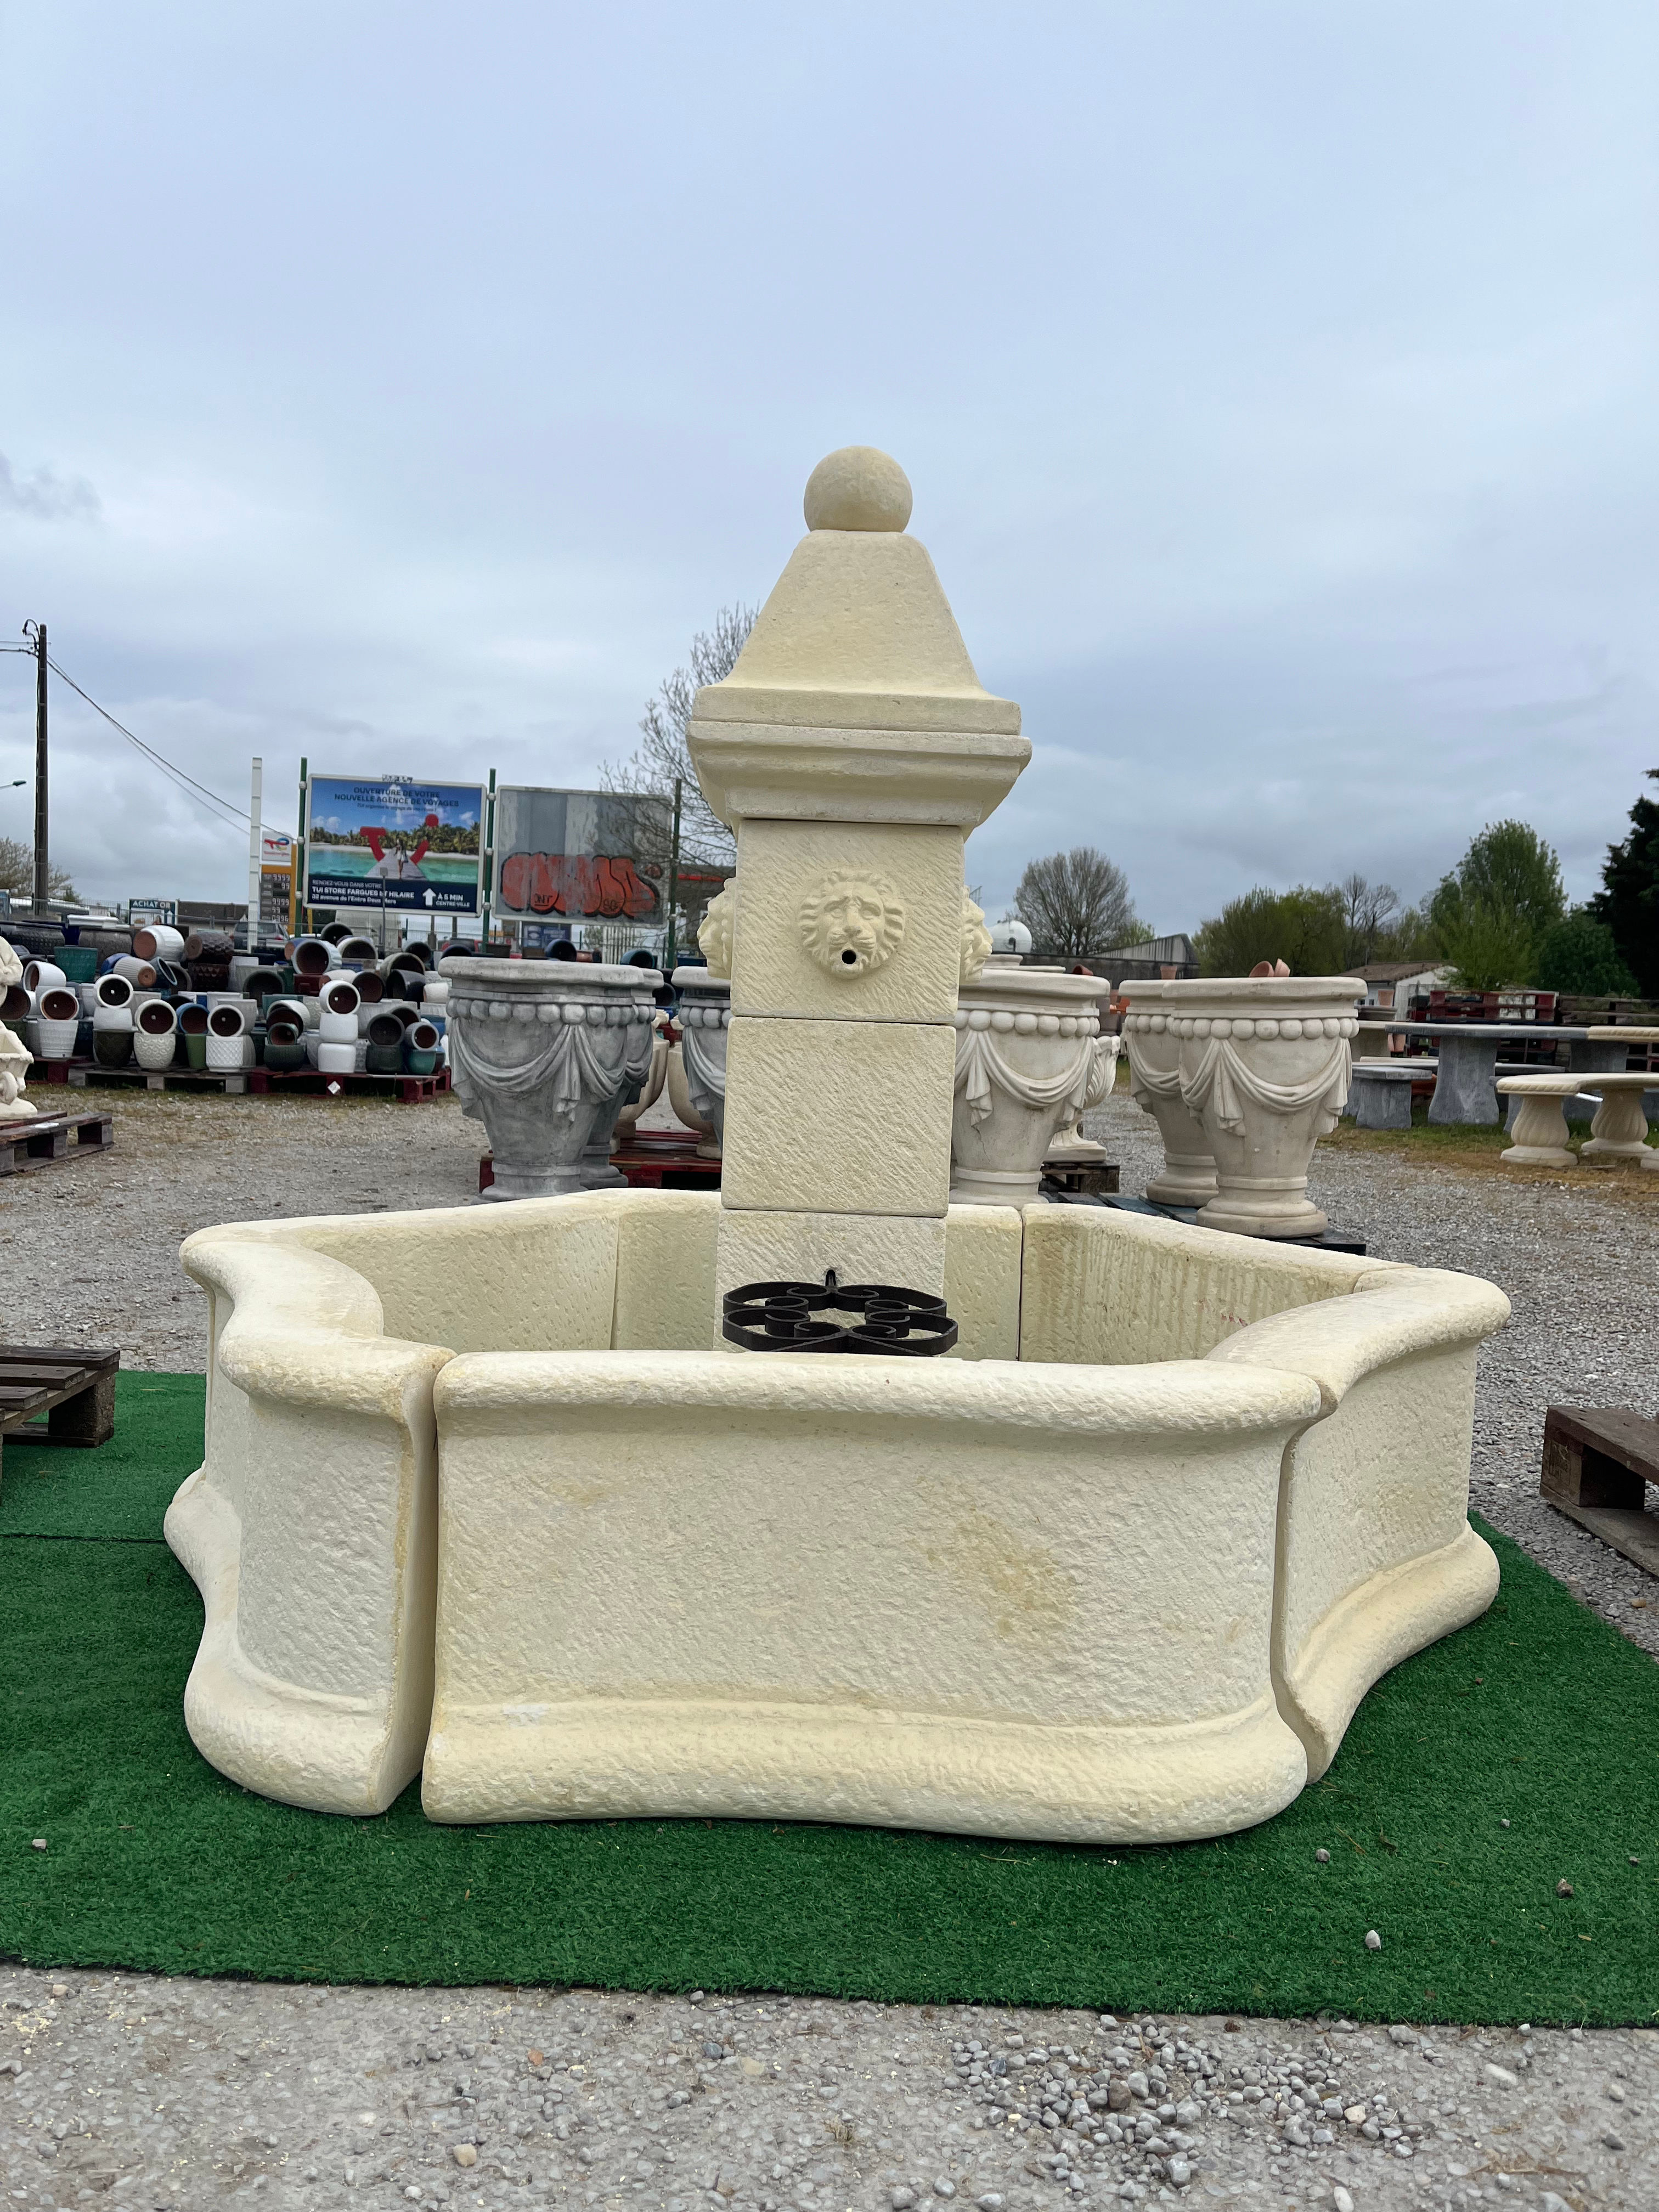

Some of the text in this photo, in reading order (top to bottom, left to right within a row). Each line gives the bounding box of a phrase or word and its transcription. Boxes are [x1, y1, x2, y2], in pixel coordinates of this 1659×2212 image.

[354, 787, 400, 796] OUVERTURE
[334, 793, 374, 802] NOUVELLE
[376, 796, 409, 804] AGENCE
